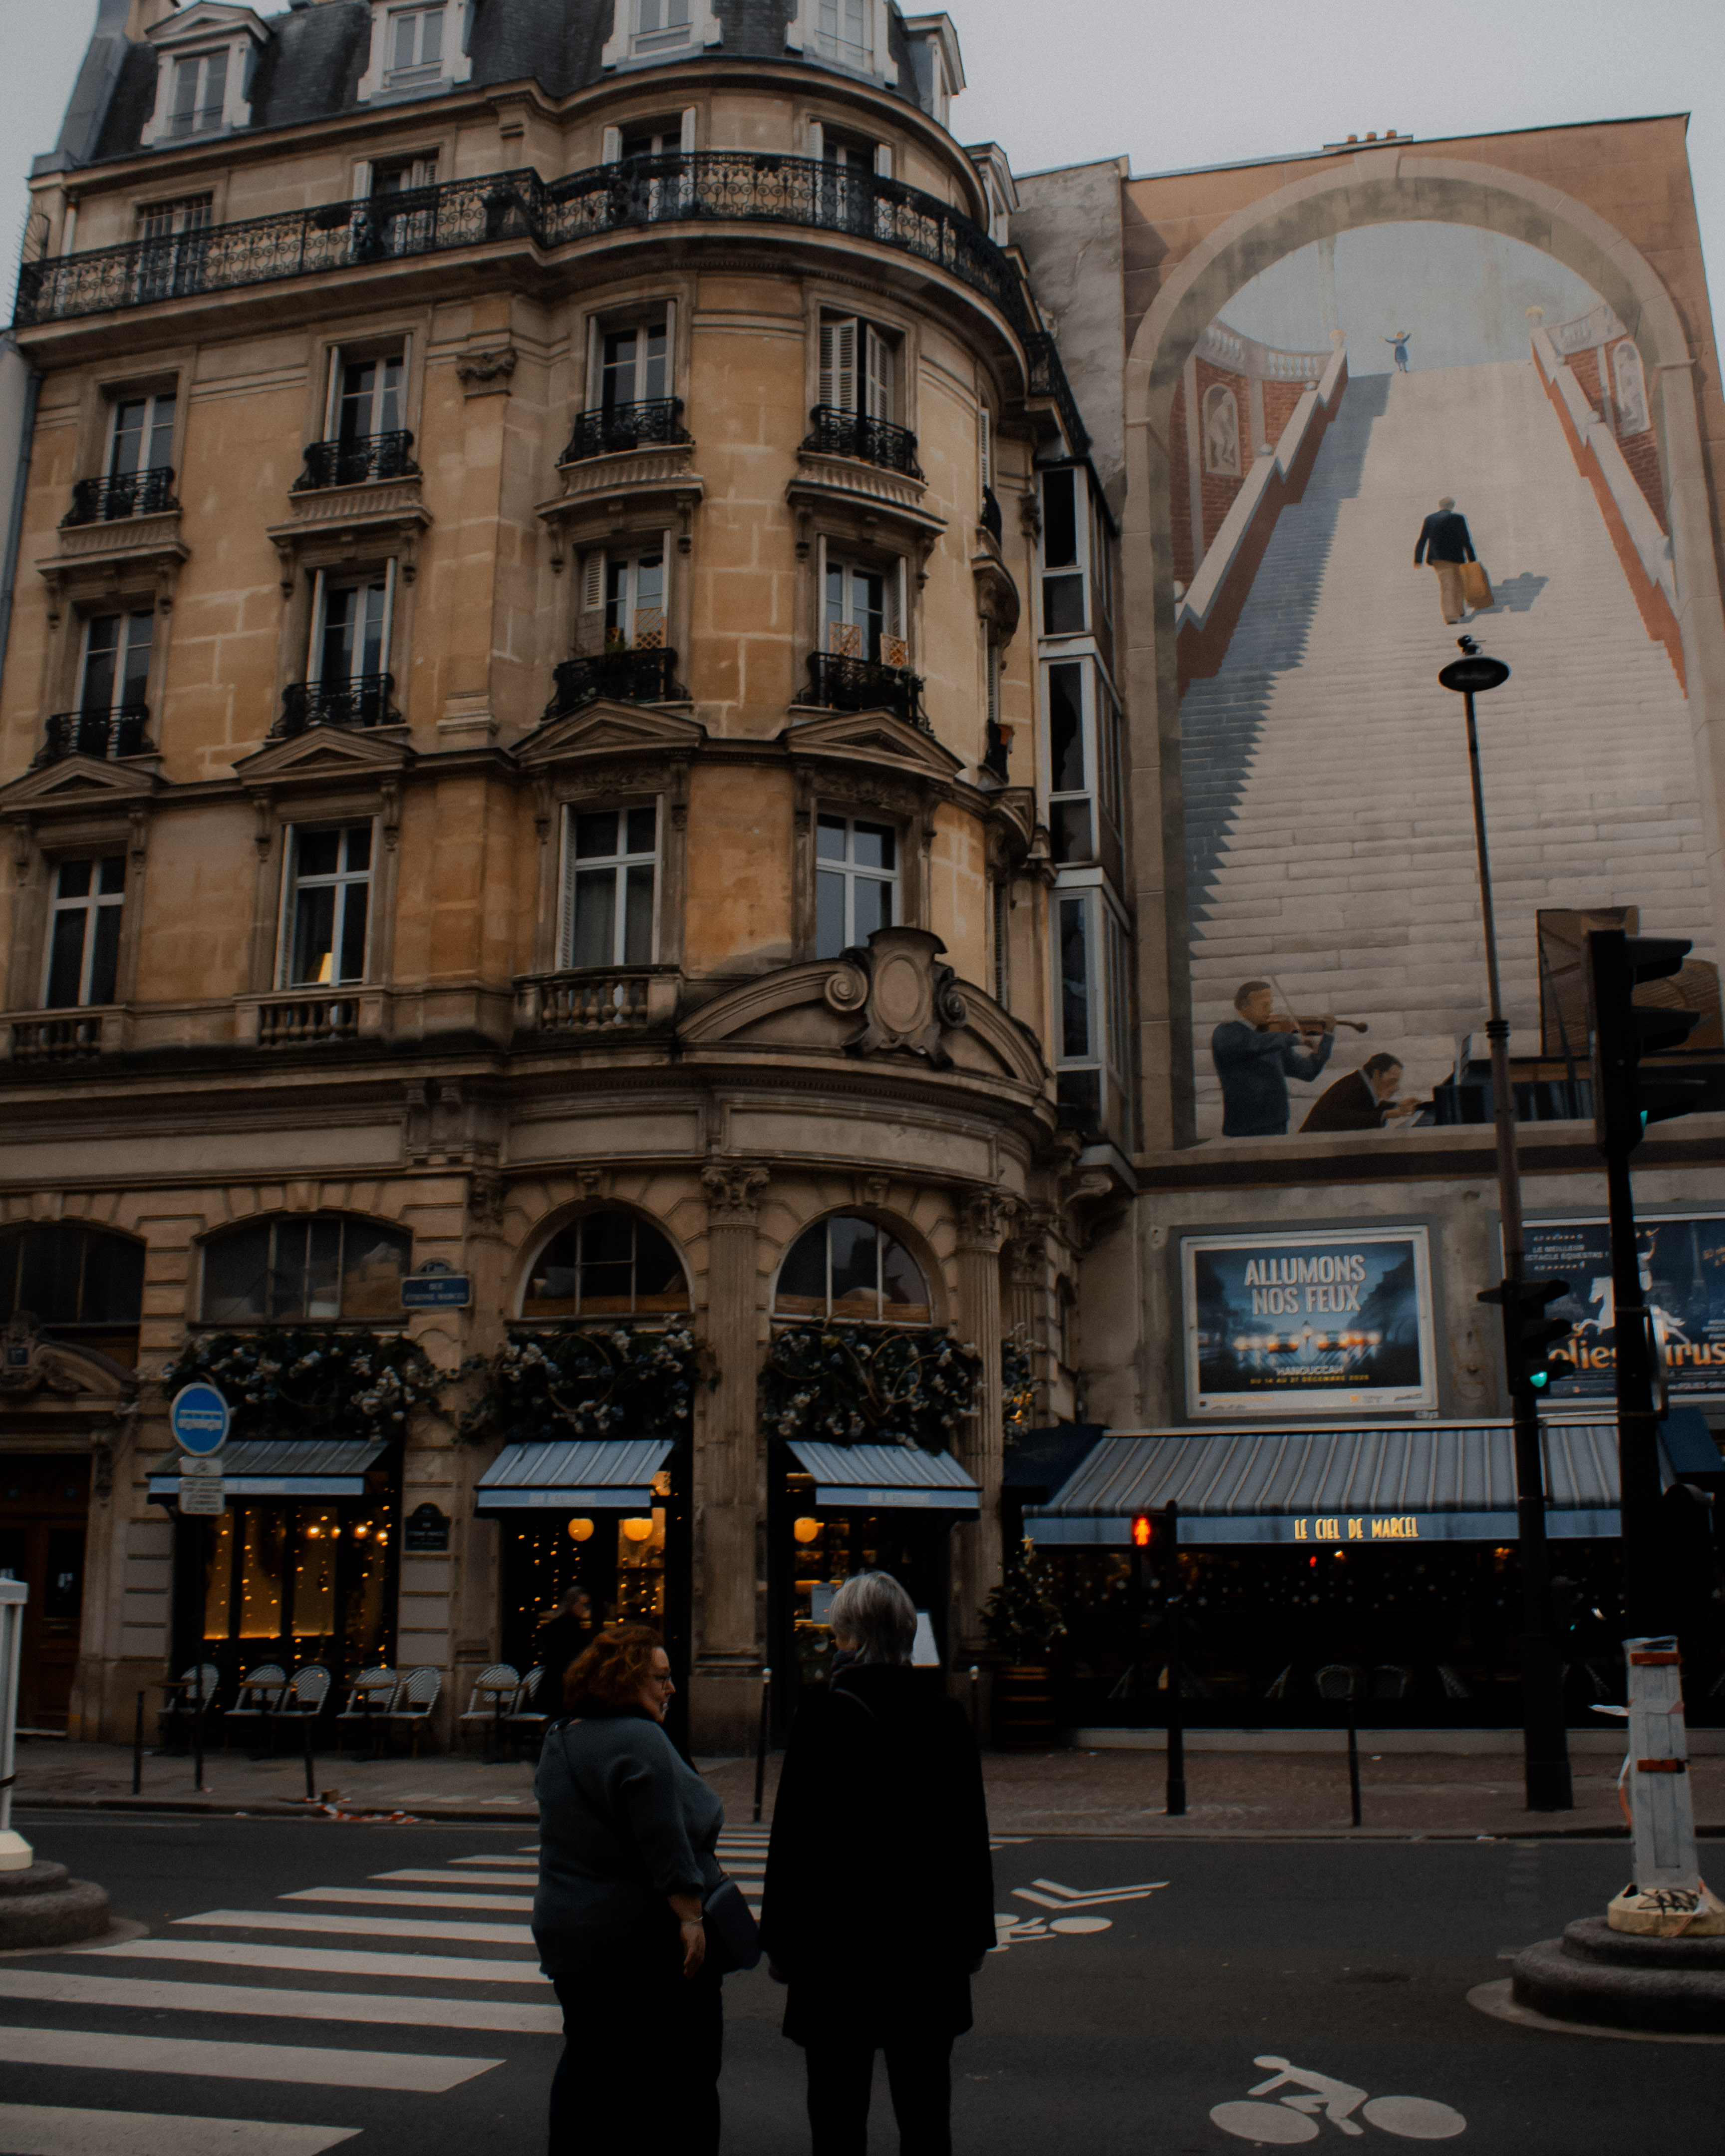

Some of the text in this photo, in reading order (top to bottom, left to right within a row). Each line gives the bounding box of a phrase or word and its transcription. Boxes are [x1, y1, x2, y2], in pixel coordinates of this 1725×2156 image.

[1244, 1254, 1366, 1287] ALLUMONS
[1251, 1285, 1362, 1315] NOS FEUX
[1294, 1517, 1419, 1540] LE CIEL DE MARCEL
